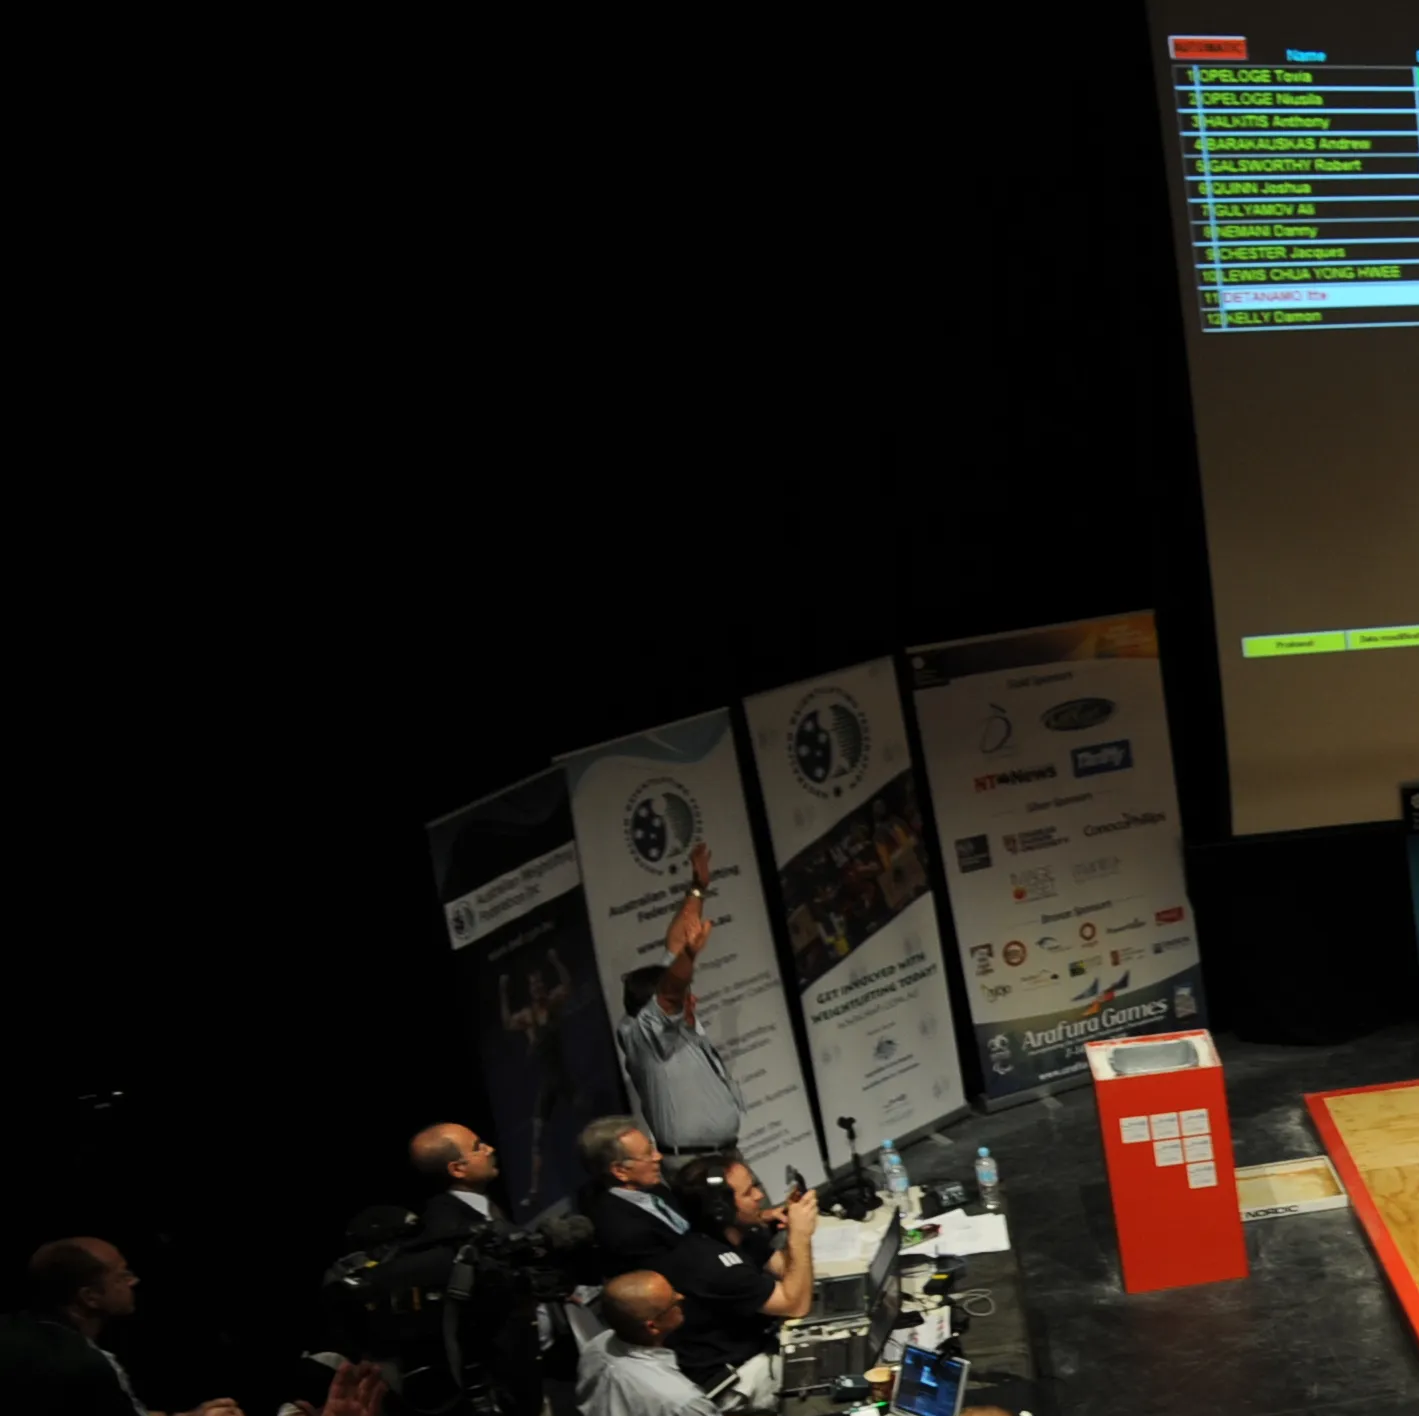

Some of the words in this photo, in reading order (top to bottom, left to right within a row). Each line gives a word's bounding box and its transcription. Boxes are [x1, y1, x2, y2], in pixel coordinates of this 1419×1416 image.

[1286, 49, 1327, 62] Name
[1008, 764, 1058, 785] News
[1083, 811, 1167, 838] ConocoPhillips
[816, 988, 841, 1005] GET
[1021, 1017, 1101, 1052] Arafura
[1101, 997, 1170, 1027] Games
